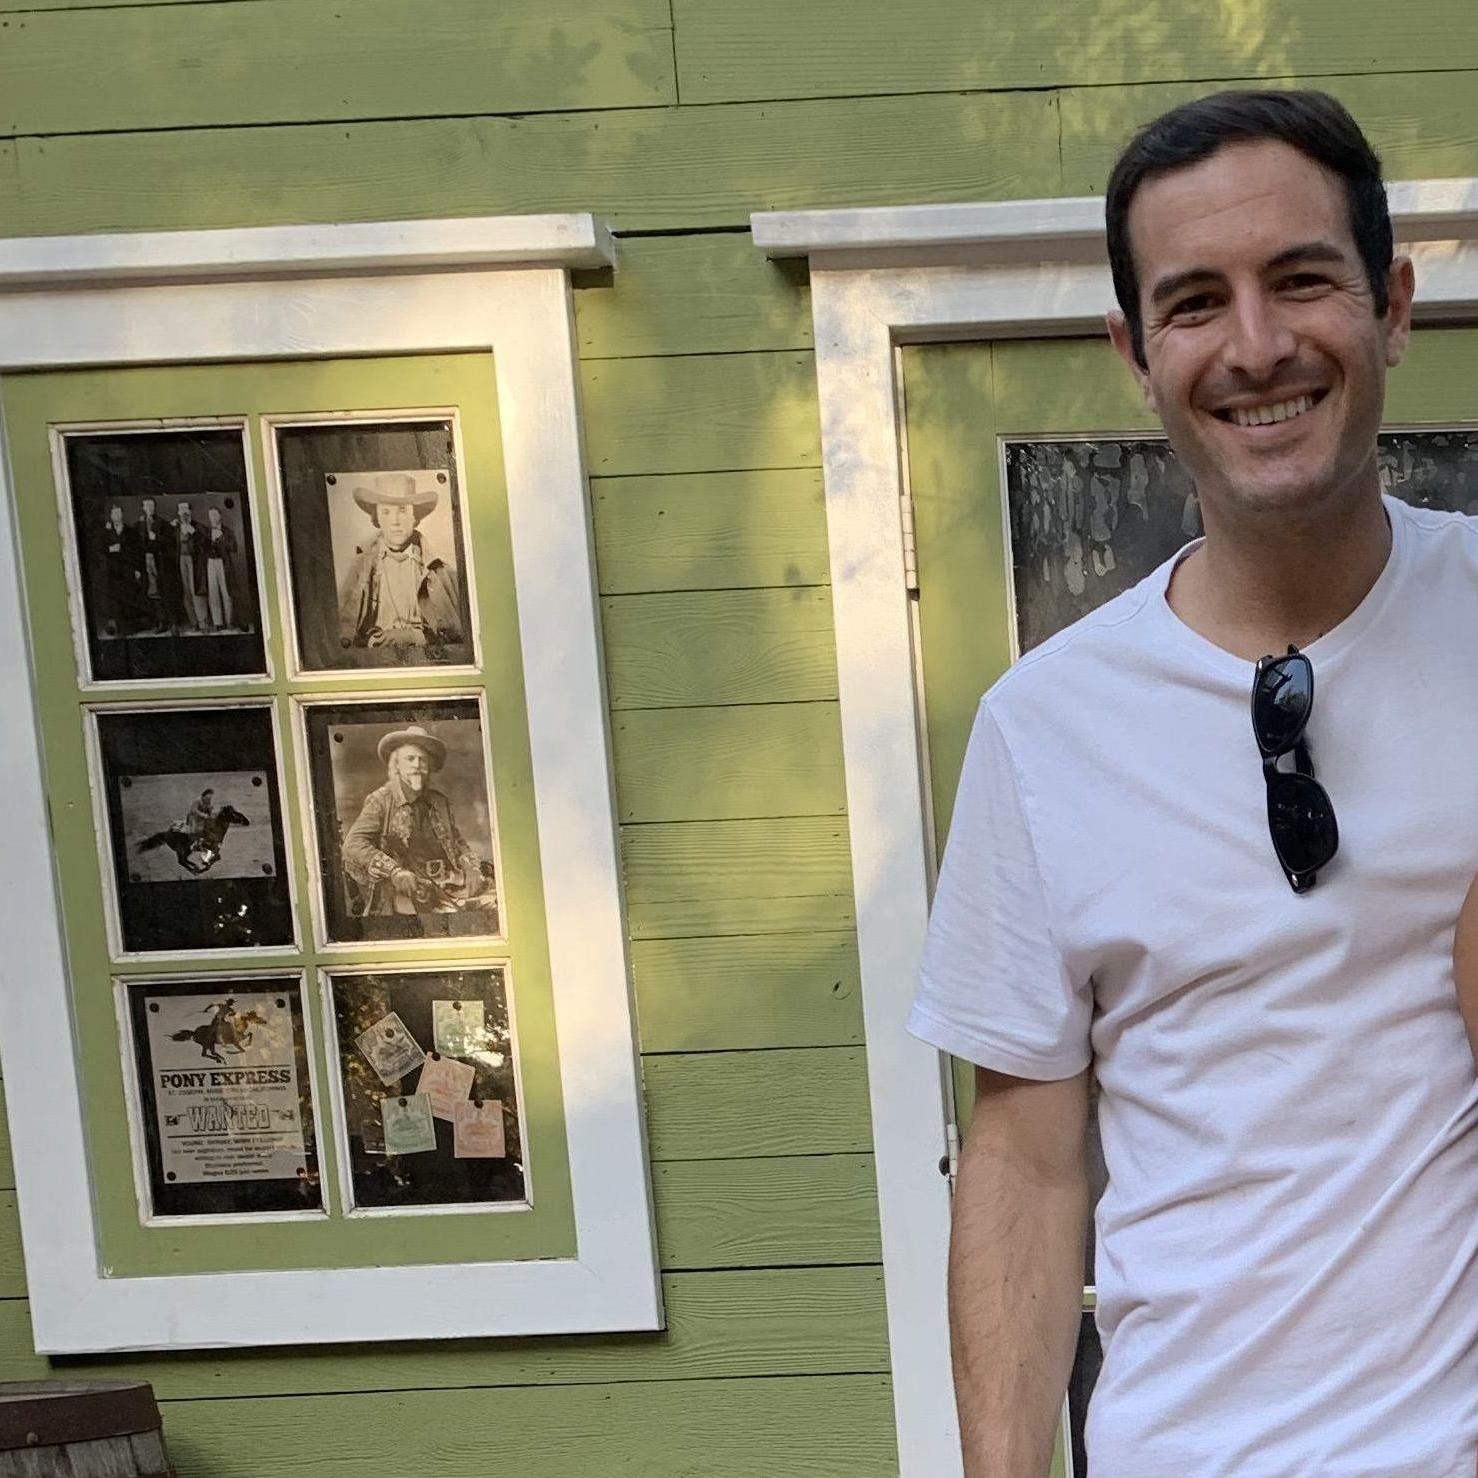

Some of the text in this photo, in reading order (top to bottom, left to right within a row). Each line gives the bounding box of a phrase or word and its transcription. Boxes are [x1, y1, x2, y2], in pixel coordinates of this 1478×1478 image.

[161, 1070, 290, 1088] PONY EXPRESS
[187, 1104, 270, 1132] WANTED
